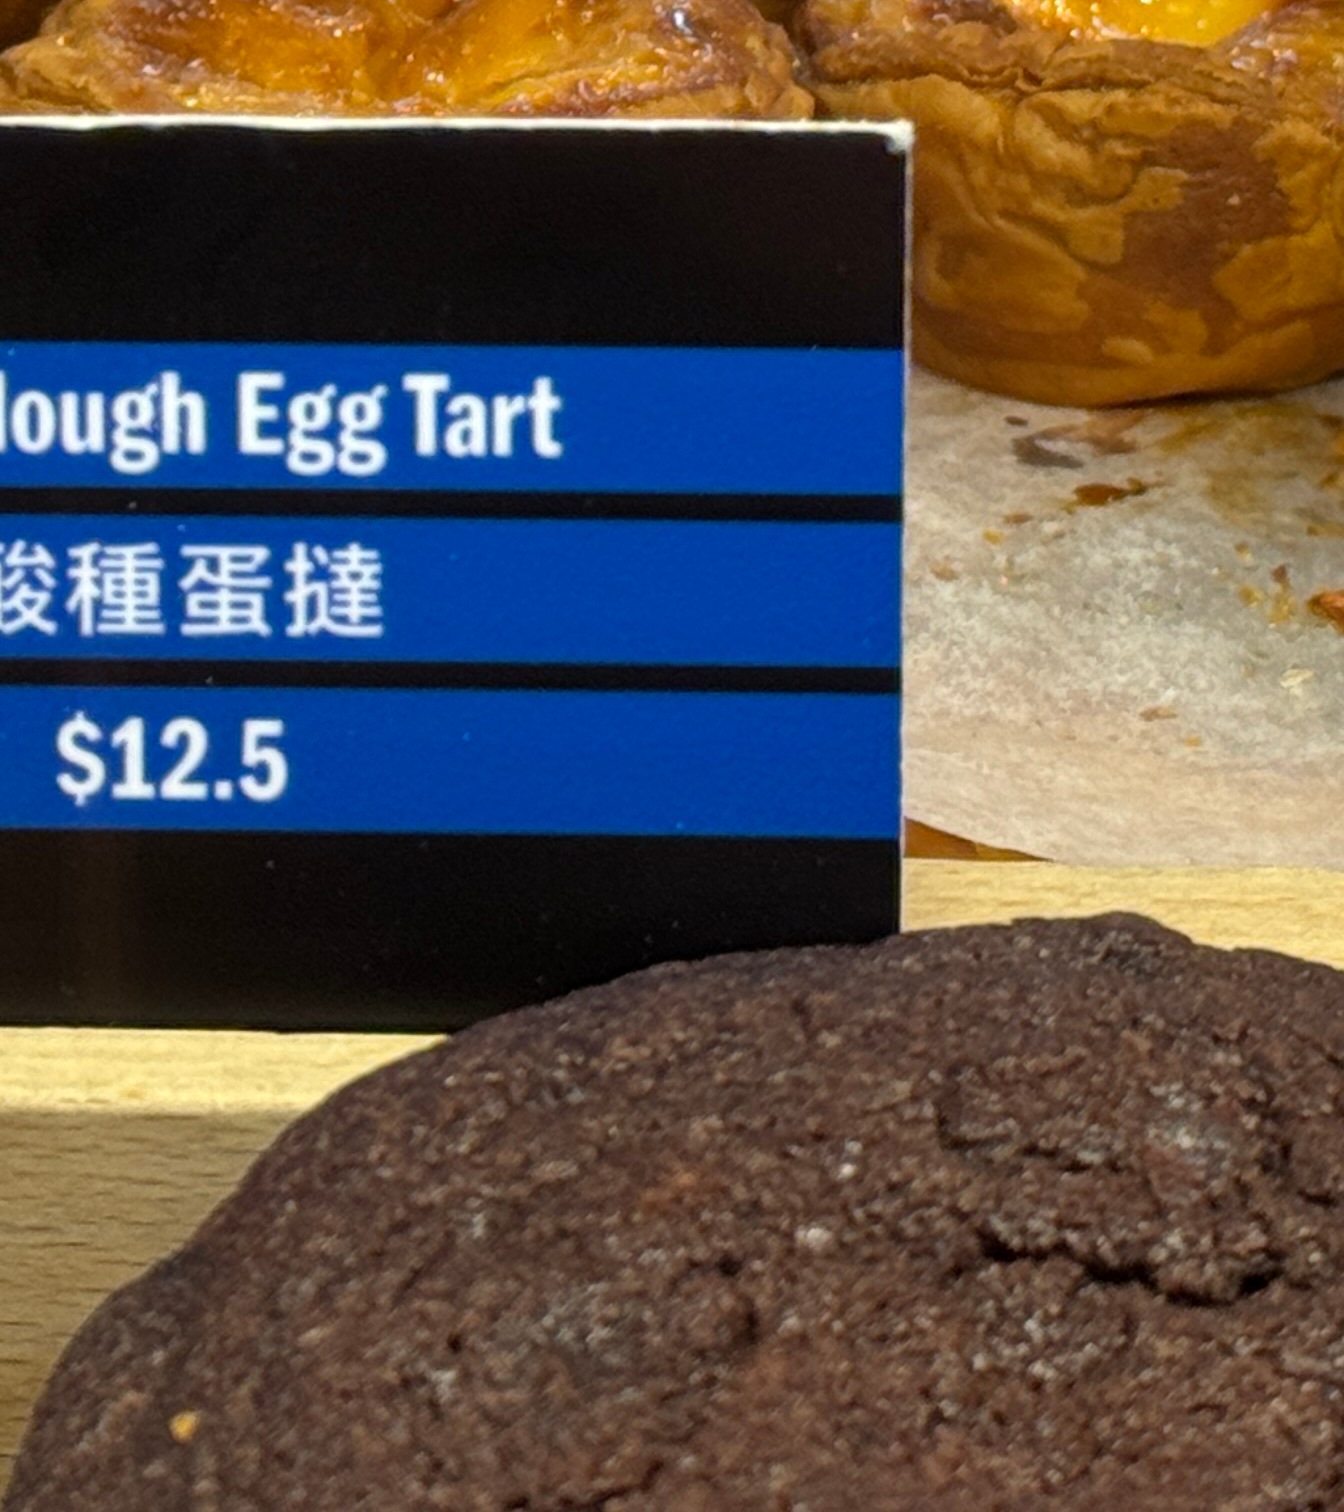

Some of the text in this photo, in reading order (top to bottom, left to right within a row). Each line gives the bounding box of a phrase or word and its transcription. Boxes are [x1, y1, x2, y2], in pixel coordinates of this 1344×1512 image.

[237, 370, 387, 477] Egg
[401, 372, 563, 459] Tart
[55, 710, 289, 807] $12.5
